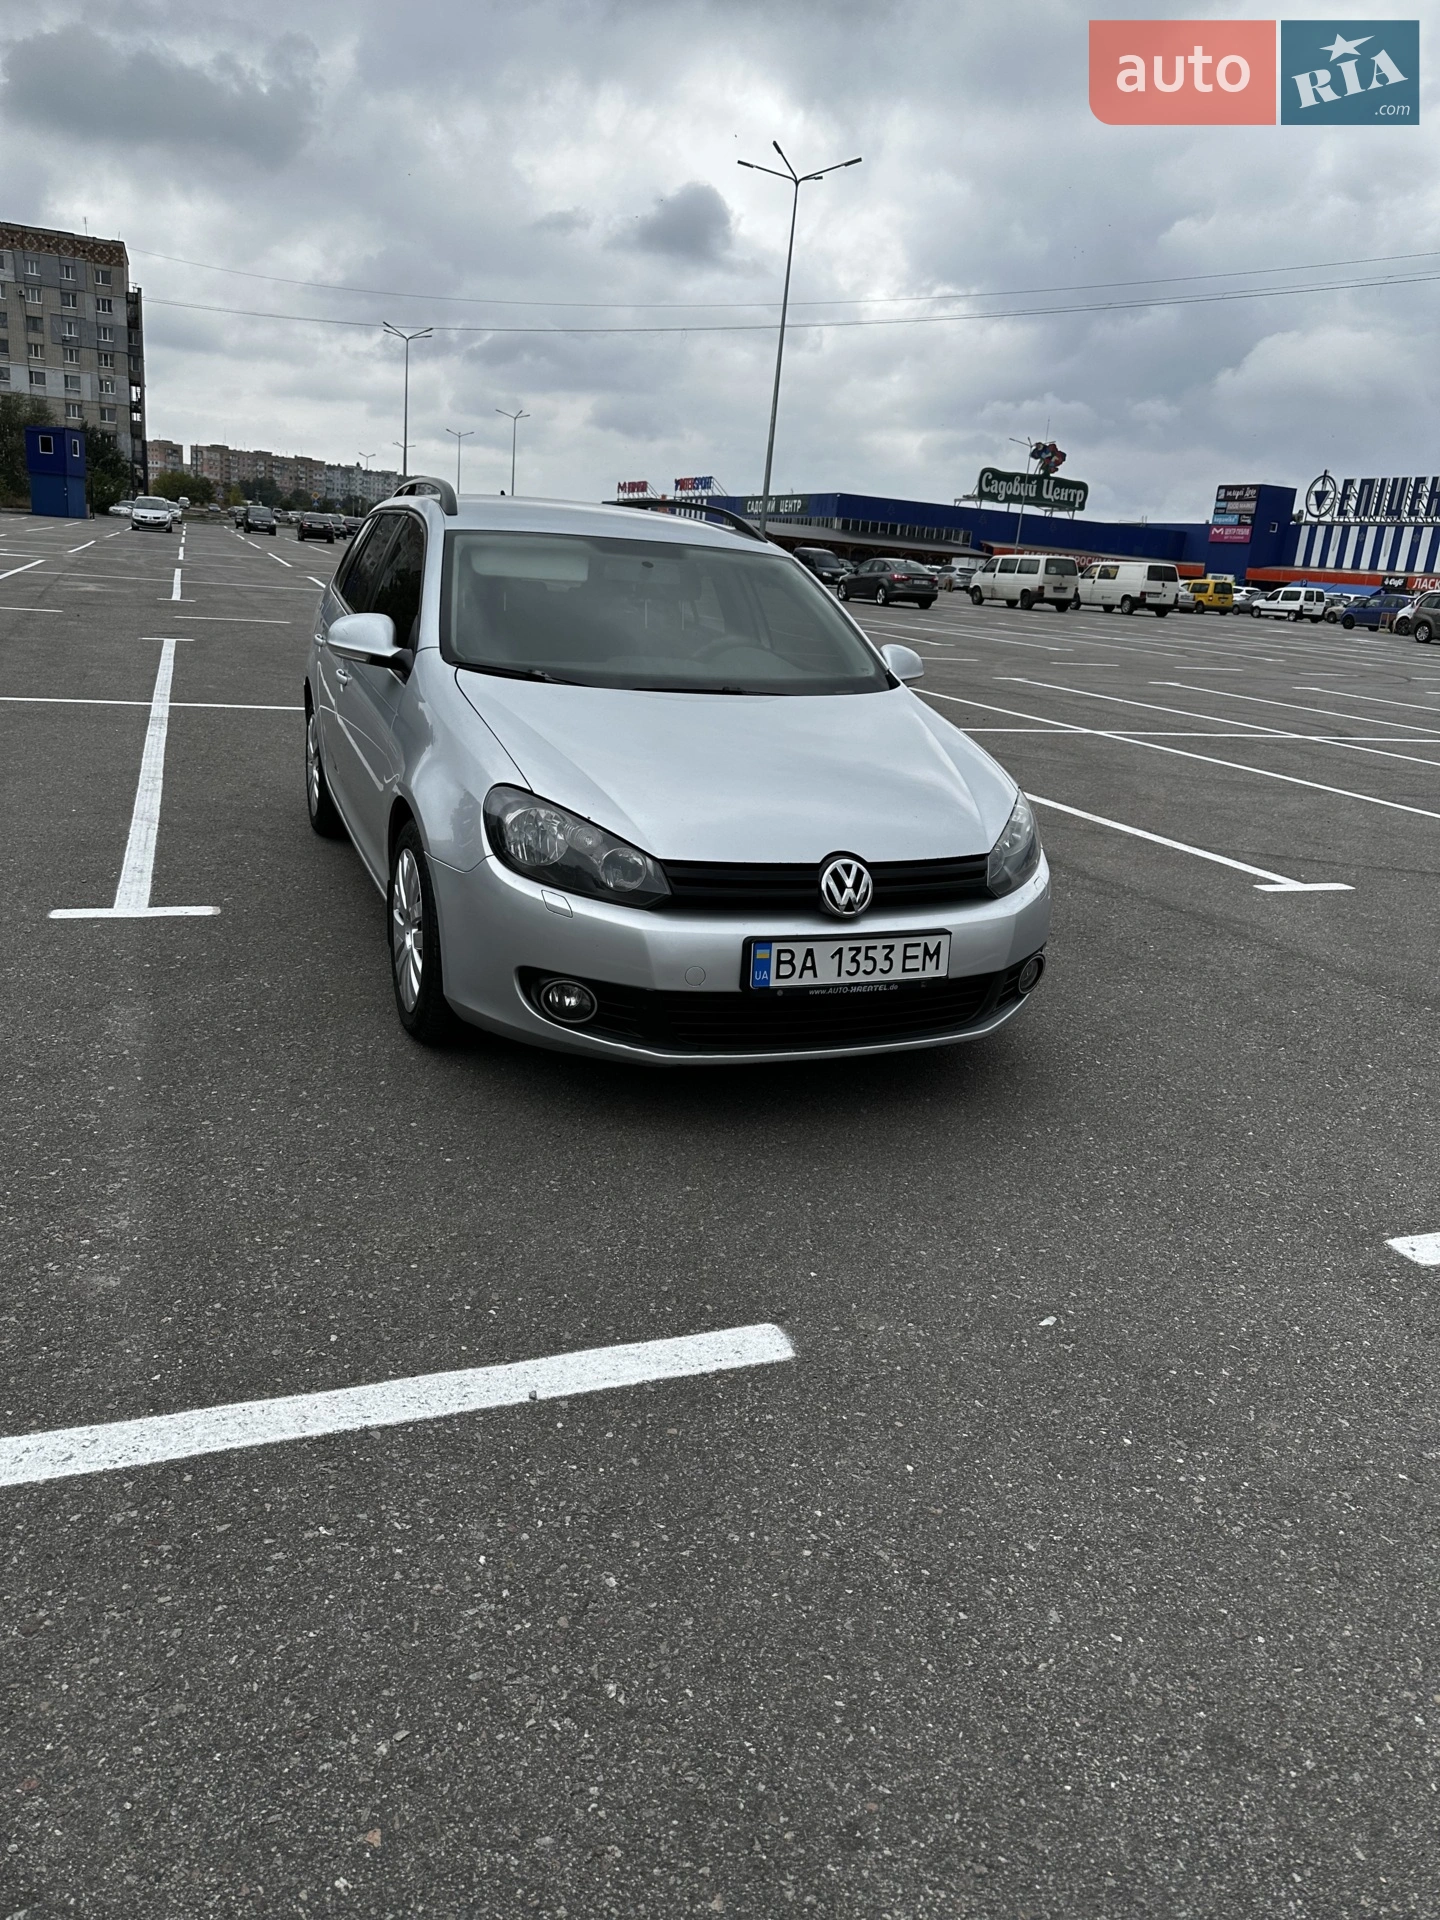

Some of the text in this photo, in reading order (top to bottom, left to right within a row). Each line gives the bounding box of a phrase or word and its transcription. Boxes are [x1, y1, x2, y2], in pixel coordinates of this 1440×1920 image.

[981, 472, 1085, 507] Садовий Центр
[747, 497, 802, 514] САДОИЙ ЦЕНТР
[775, 940, 942, 980] BA 1353 EM
[754, 971, 769, 981] UA
